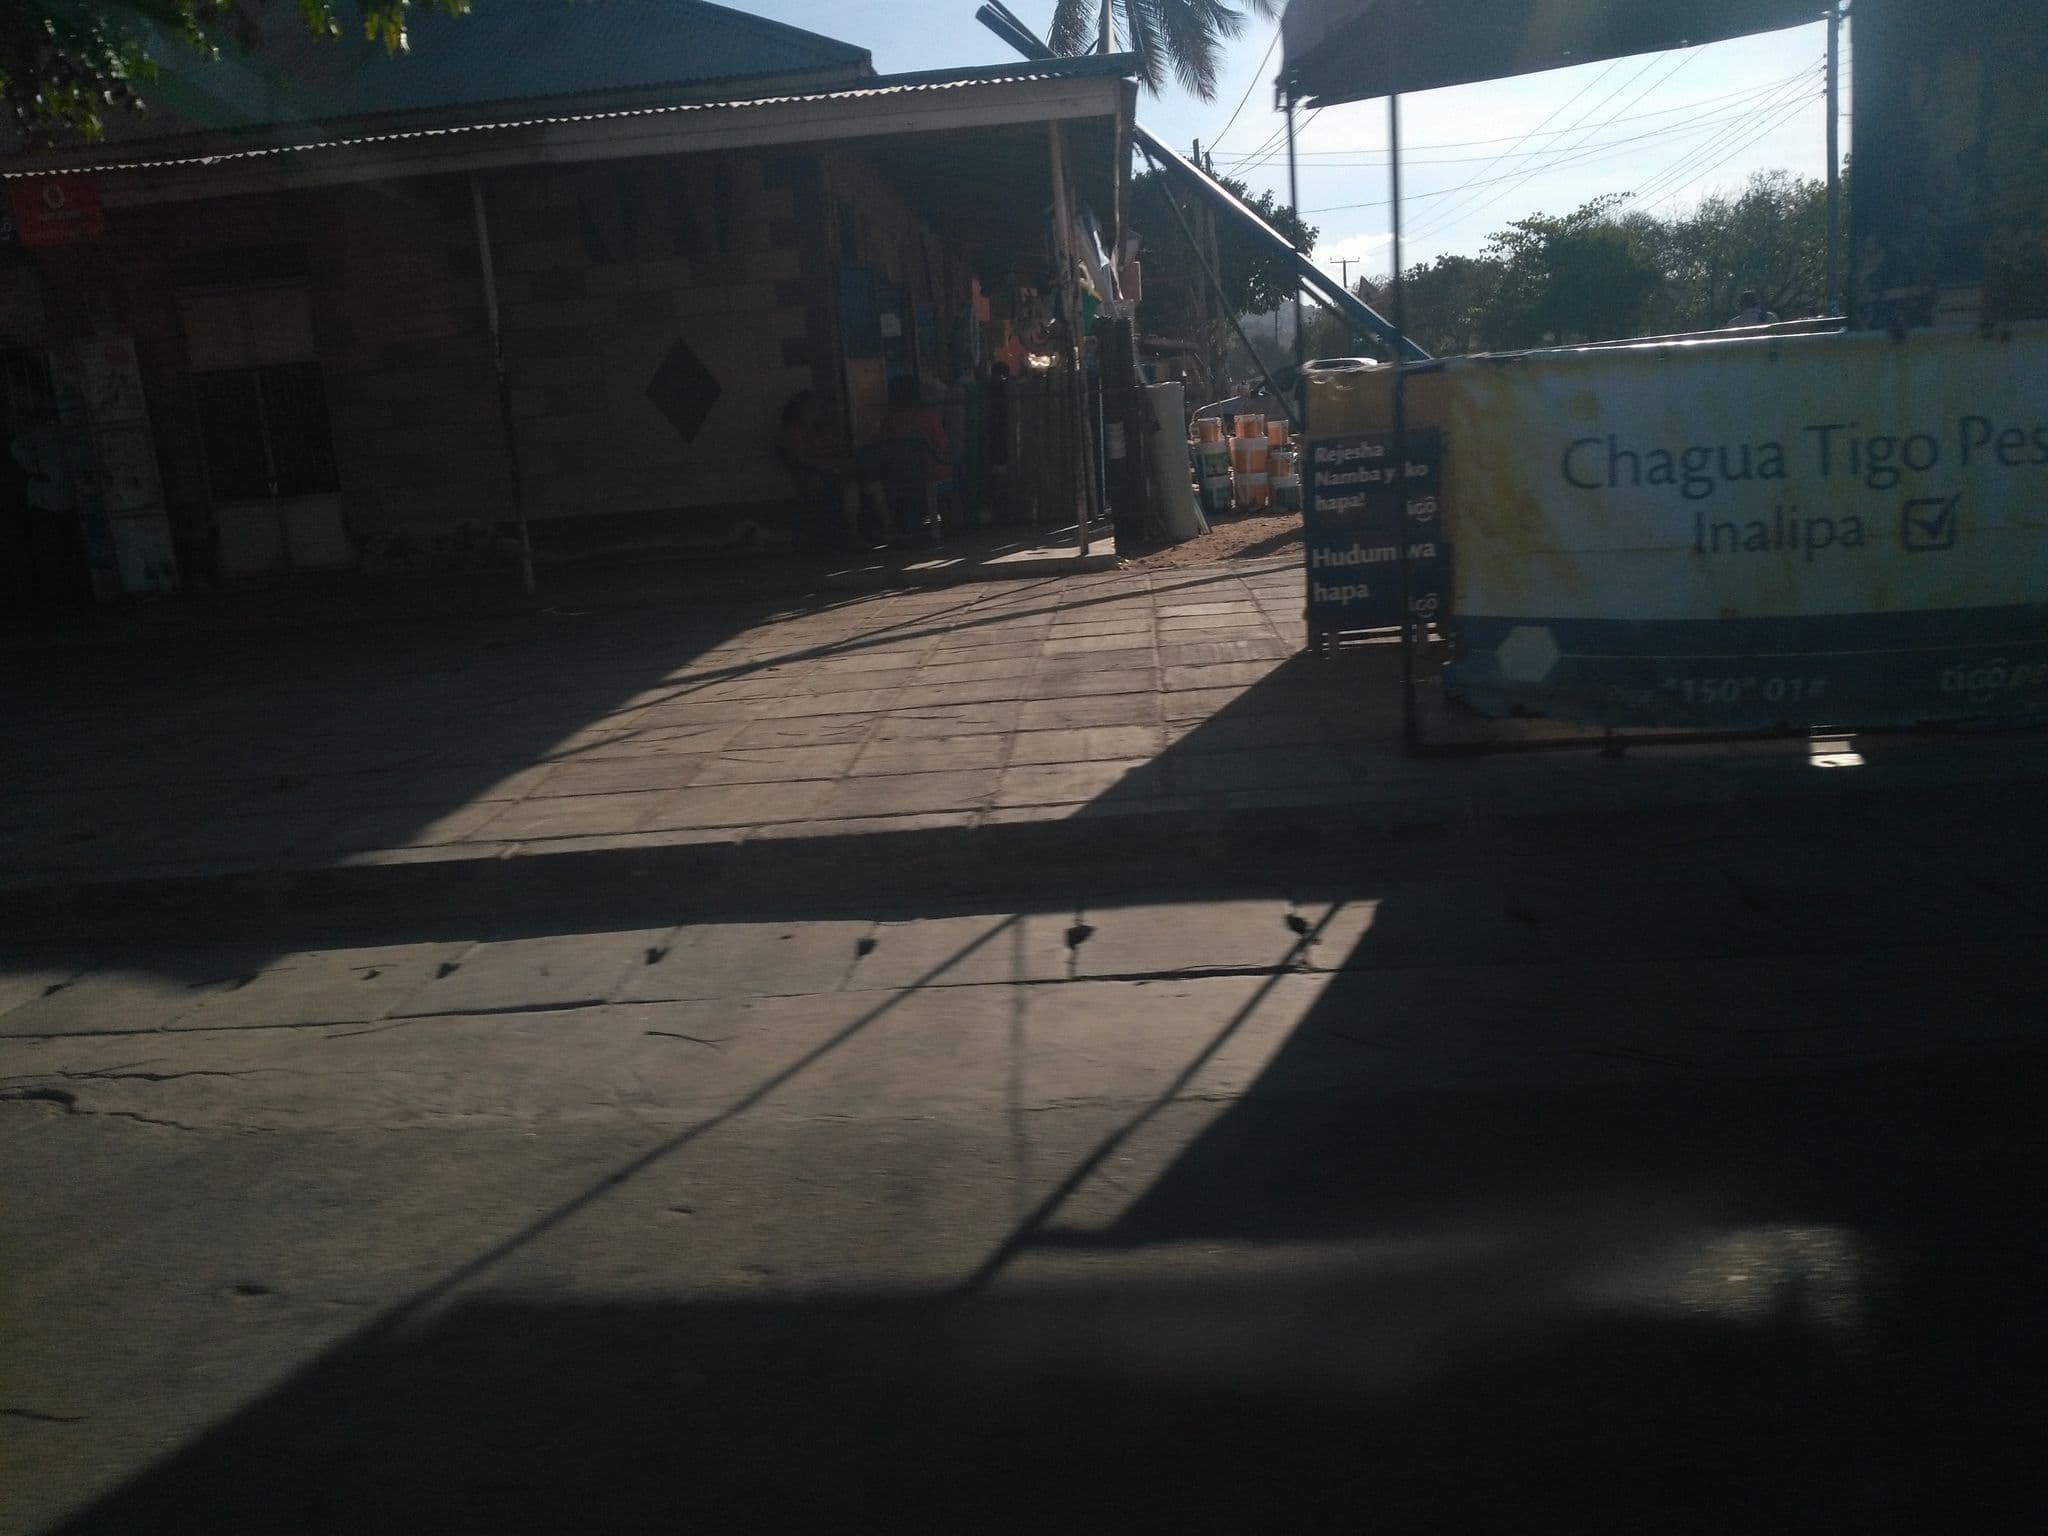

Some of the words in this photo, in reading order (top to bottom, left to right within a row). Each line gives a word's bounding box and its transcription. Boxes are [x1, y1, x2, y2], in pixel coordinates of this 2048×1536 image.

[1314, 442, 1385, 465] Rejesha
[1562, 434, 1787, 499] Chagua
[1803, 421, 1939, 490] Tigo
[1314, 467, 1381, 487] Namba
[1694, 505, 1866, 562] Inalipa
[1313, 582, 1369, 605] hapa
